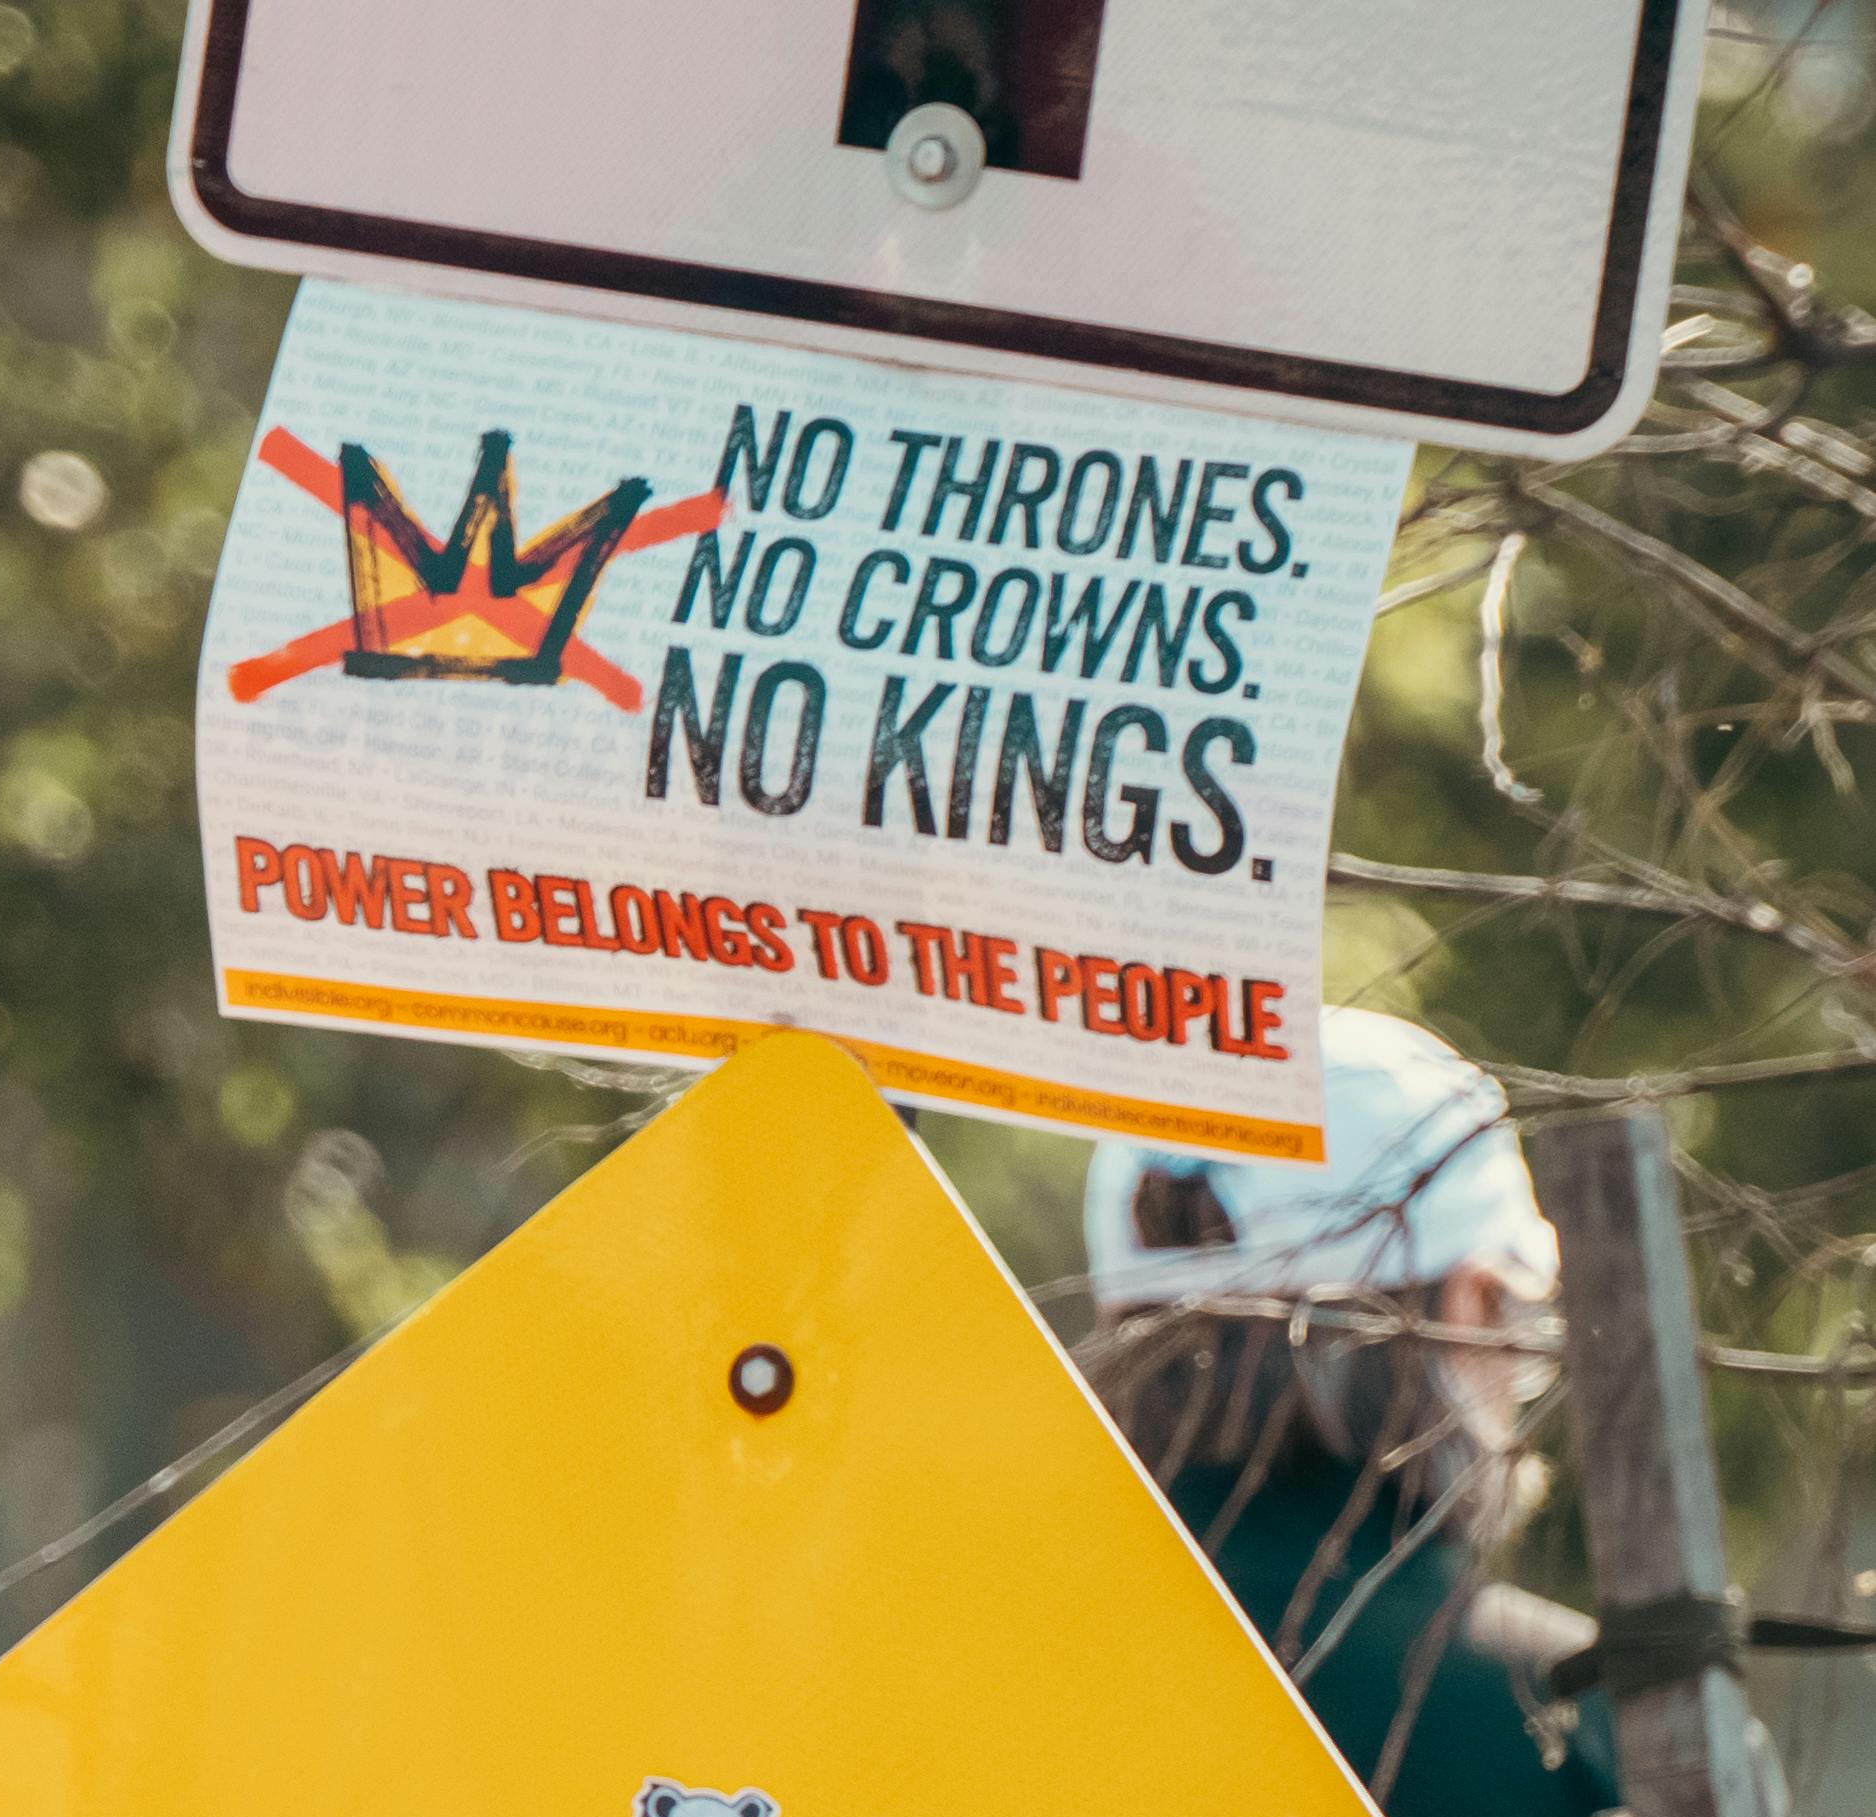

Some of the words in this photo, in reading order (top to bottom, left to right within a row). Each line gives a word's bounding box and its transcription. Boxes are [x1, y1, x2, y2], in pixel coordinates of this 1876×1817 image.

[714, 405, 853, 521] NO
[880, 430, 1308, 578] THRONES.
[671, 528, 815, 637] NO
[838, 550, 1260, 699] CROWNS.
[645, 647, 825, 816] NO
[862, 676, 1273, 883] KINGS.
[236, 833, 479, 939] POWER
[487, 868, 794, 975] BELONGS
[798, 906, 890, 988] TO
[894, 918, 1027, 1015] THE
[1032, 948, 1294, 1062] PEOPLE
[243, 978, 393, 1019] indivisible.org
[411, 1000, 628, 1042] commoncause.org
